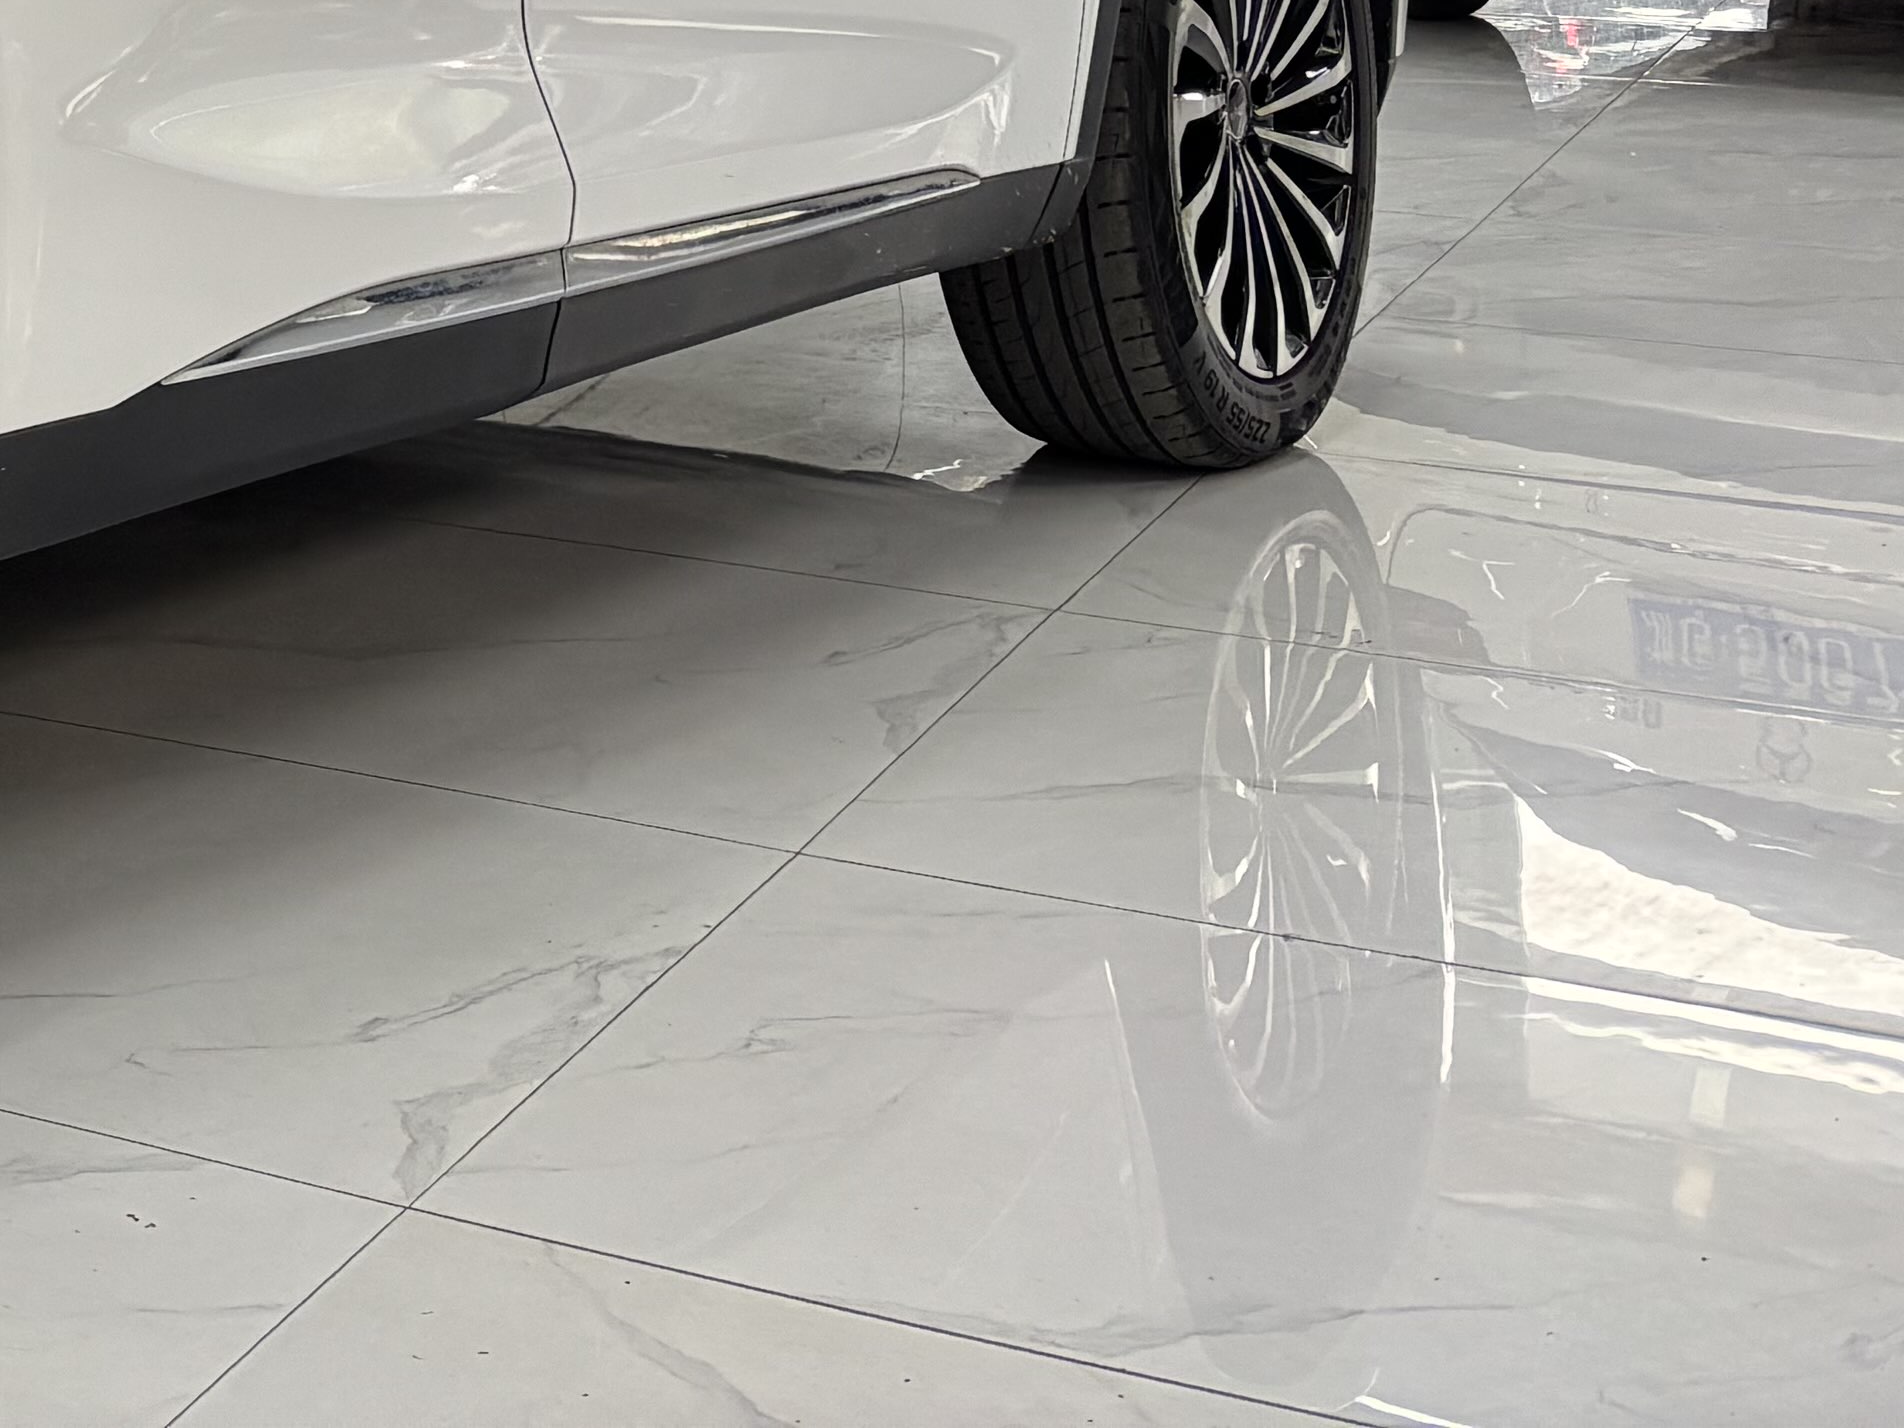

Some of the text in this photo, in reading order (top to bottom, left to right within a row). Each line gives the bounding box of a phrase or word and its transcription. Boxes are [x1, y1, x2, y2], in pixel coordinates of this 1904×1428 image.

[1204, 369, 1220, 397] 19
[1216, 386, 1229, 412] R
[1226, 402, 1271, 443] 225/55
